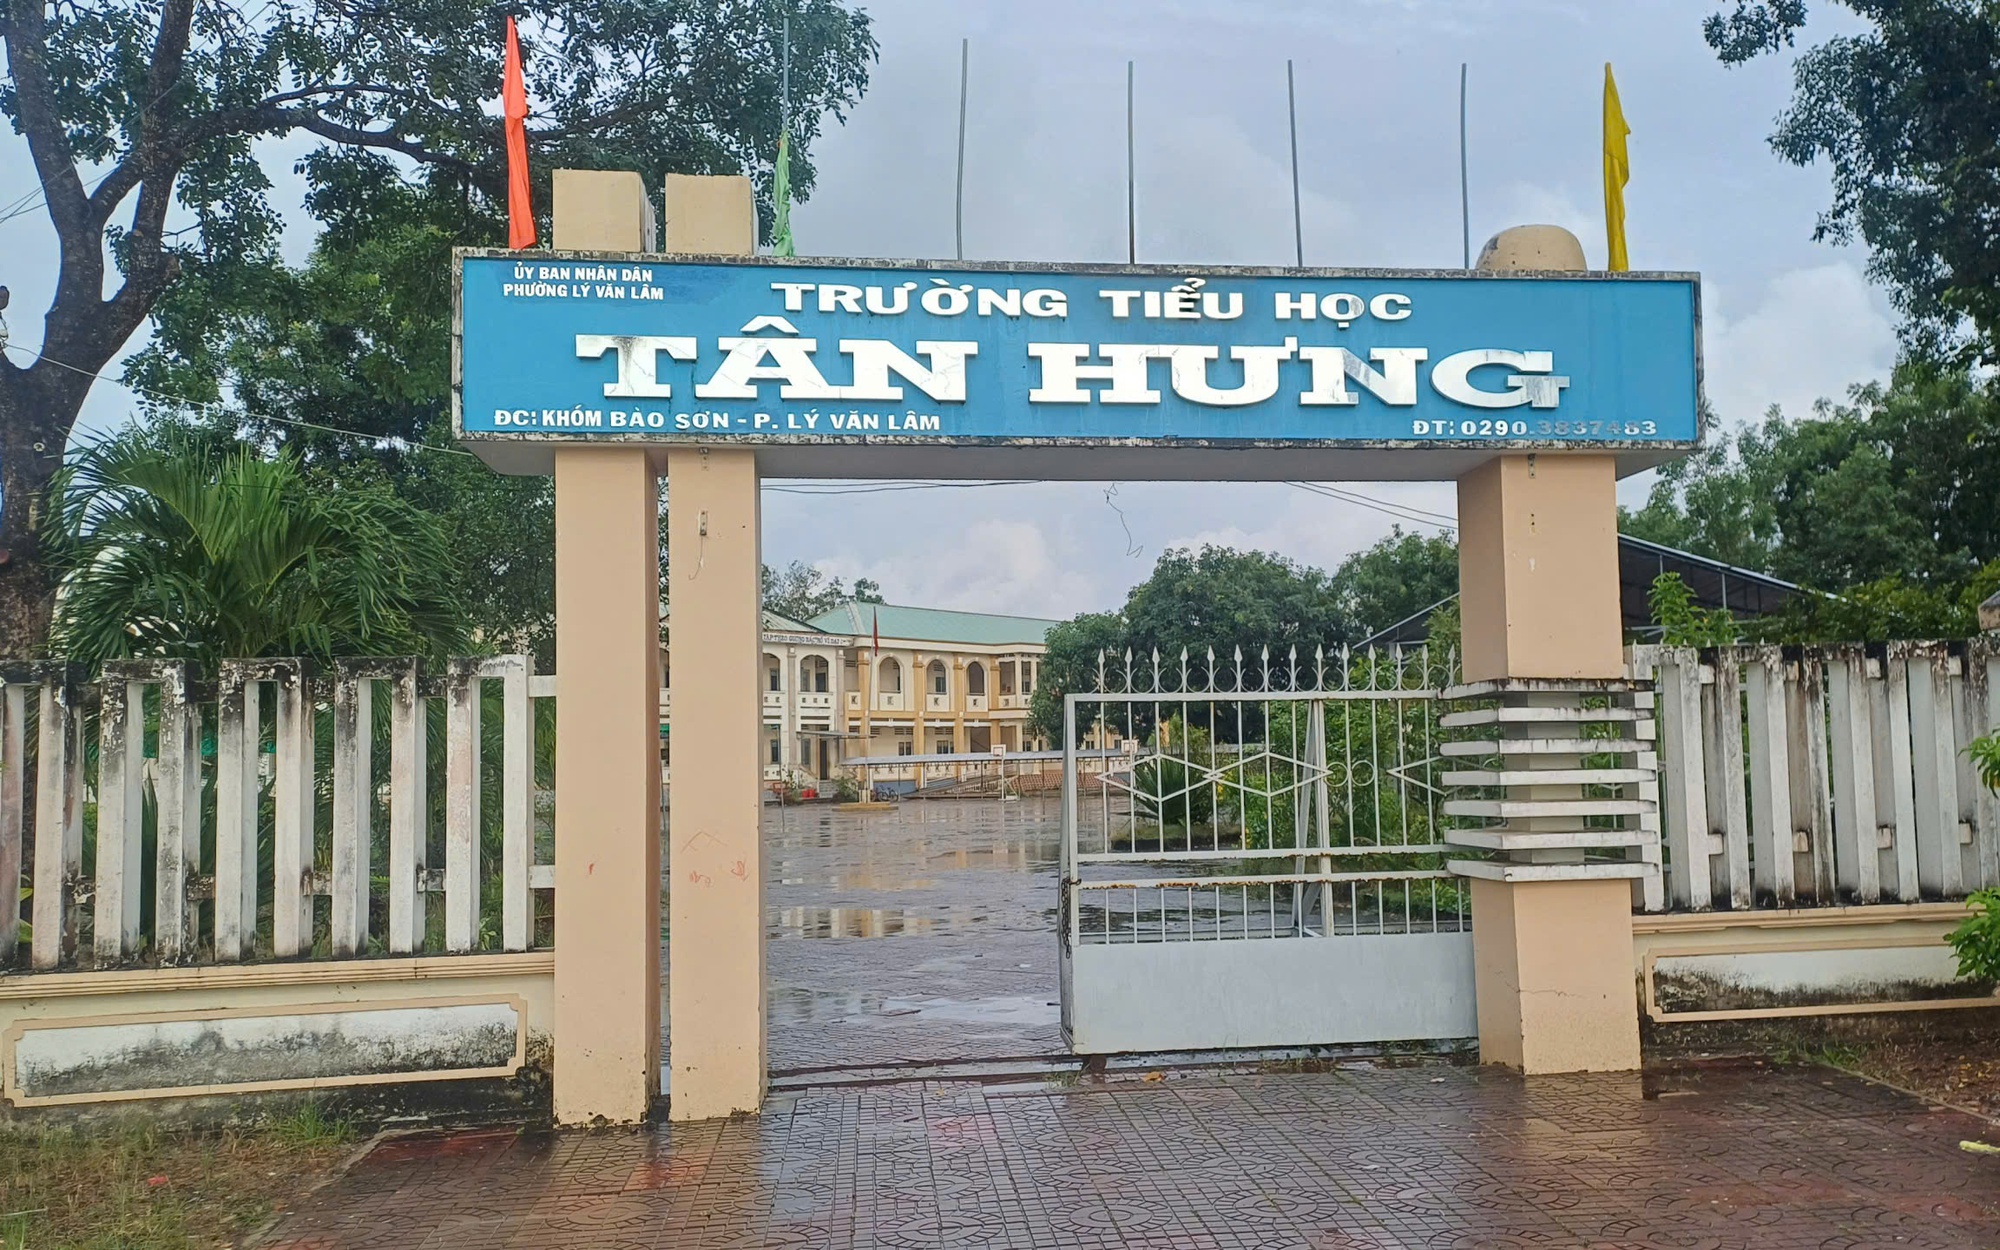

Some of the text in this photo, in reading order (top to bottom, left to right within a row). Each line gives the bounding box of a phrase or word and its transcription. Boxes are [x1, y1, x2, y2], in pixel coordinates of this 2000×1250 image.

[514, 262, 653, 283] ỦY BAN NHÂN DÂN
[503, 281, 664, 301] PHƯỜNG LÝ VĂN LÂM
[771, 278, 1412, 328] TRƯỜNG TIỂU HỌC
[575, 316, 1570, 408] TÂN HƯNG
[494, 410, 537, 426] ĐC:
[542, 405, 602, 426] KHÓM
[610, 407, 665, 428] BÀO
[675, 411, 730, 429] SƠN
[754, 413, 779, 430] P.
[787, 408, 820, 430] LÝ
[829, 411, 880, 430] VĂN
[888, 411, 941, 431] LÂM
